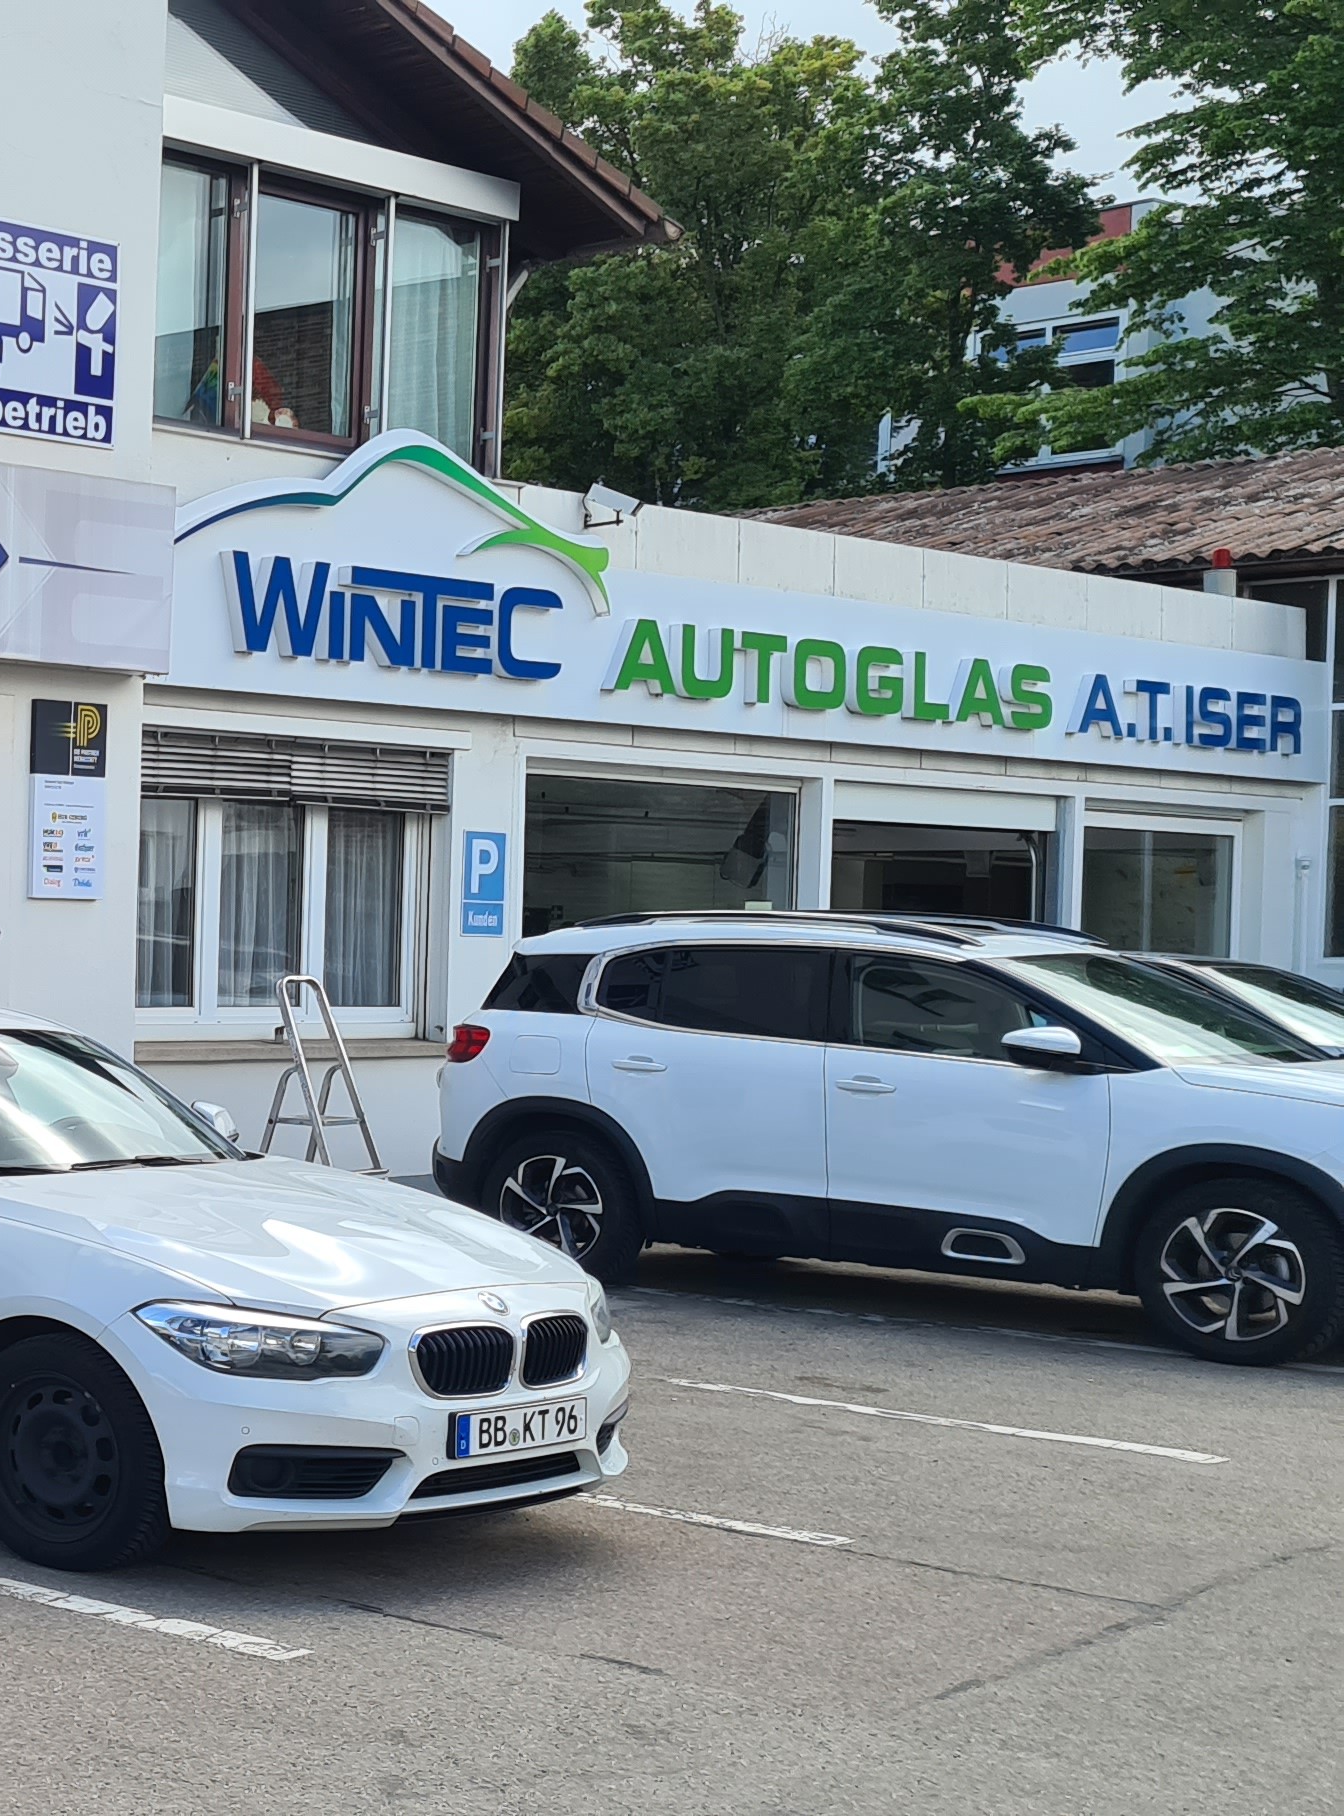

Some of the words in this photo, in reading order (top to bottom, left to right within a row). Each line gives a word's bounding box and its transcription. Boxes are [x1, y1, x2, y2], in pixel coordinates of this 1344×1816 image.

[613, 617, 1052, 732] AUTOGLAS
[1185, 685, 1302, 757] ISER
[470, 838, 499, 894] P
[468, 911, 498, 927] Kunden
[479, 1415, 507, 1450] BB
[522, 1409, 550, 1443] KT
[555, 1404, 578, 1438] 96
